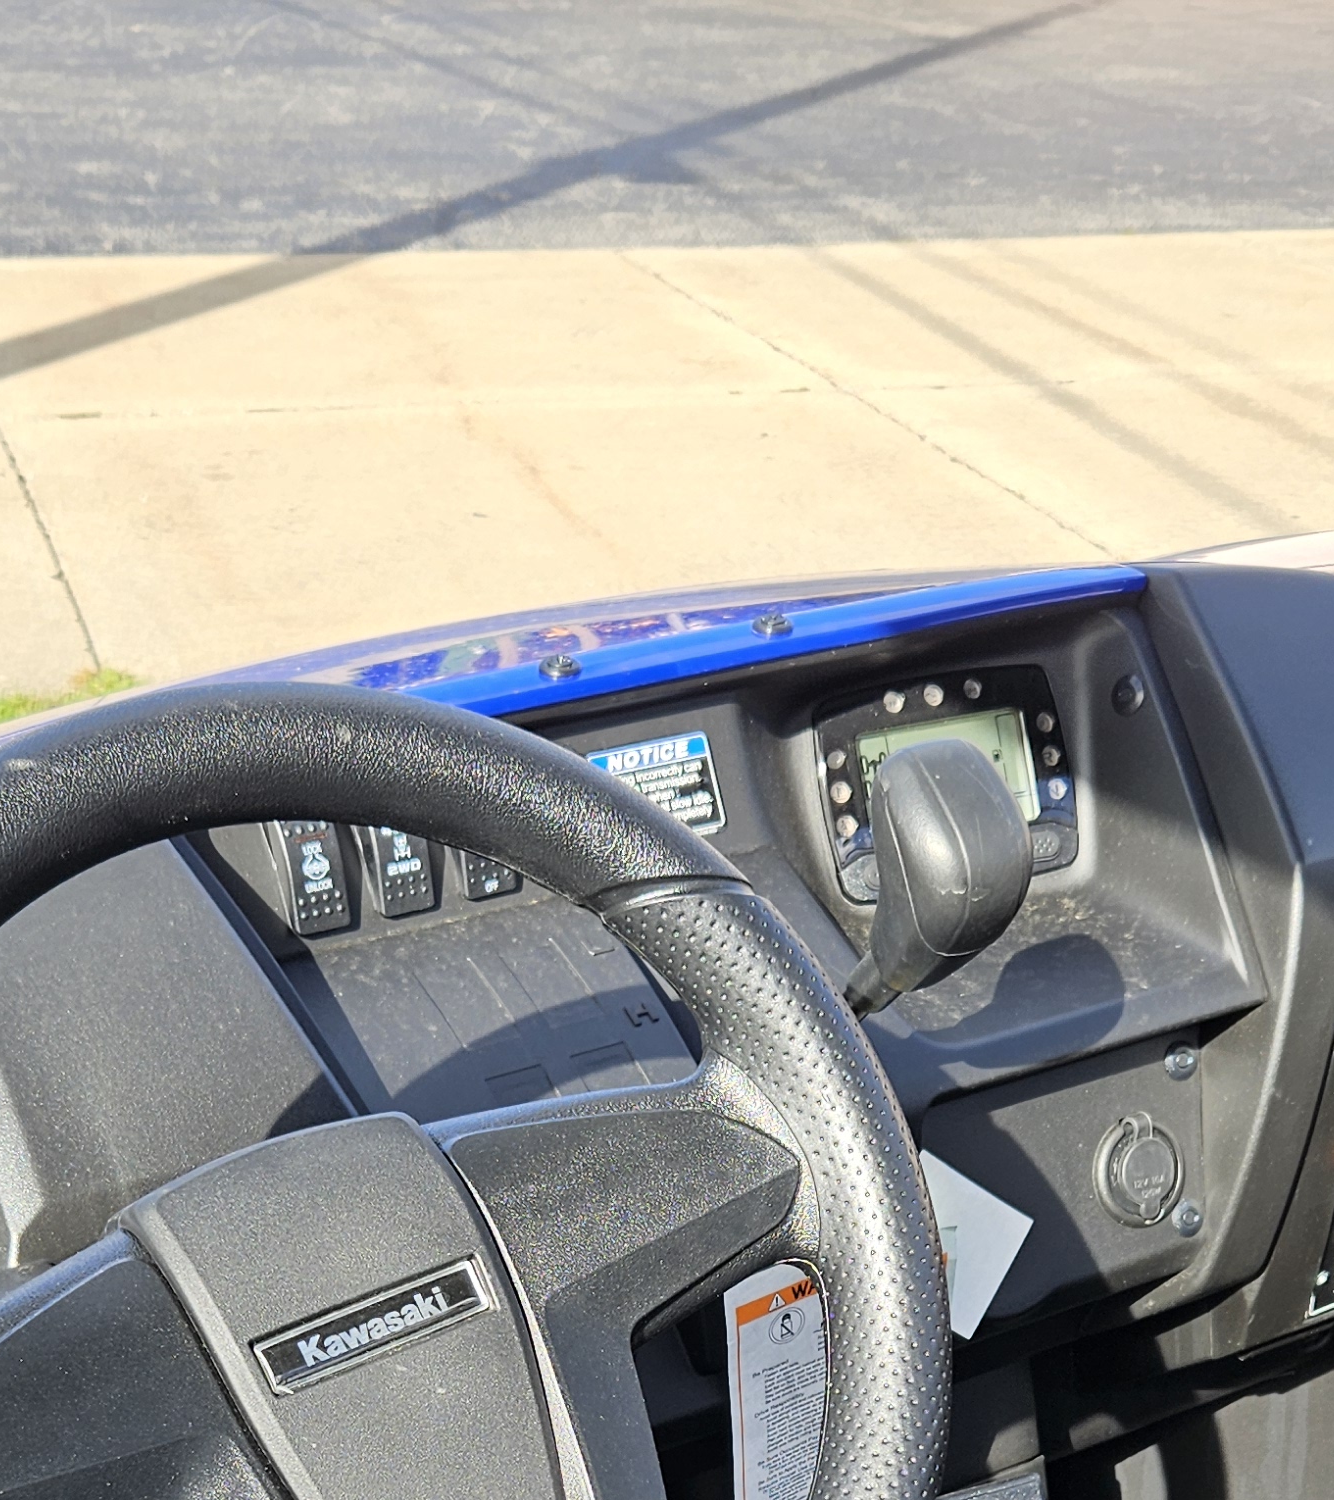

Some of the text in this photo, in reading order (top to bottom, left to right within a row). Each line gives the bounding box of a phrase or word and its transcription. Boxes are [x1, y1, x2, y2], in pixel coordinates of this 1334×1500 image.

[607, 741, 689, 772] NOTICE
[635, 764, 683, 781] incorrectly
[682, 759, 703, 773] can
[301, 840, 323, 856] LOCK
[387, 857, 421, 876] 2WD
[304, 877, 334, 893] UNLOCK
[484, 879, 499, 893] OFF
[297, 1286, 449, 1368] Kawasaki
